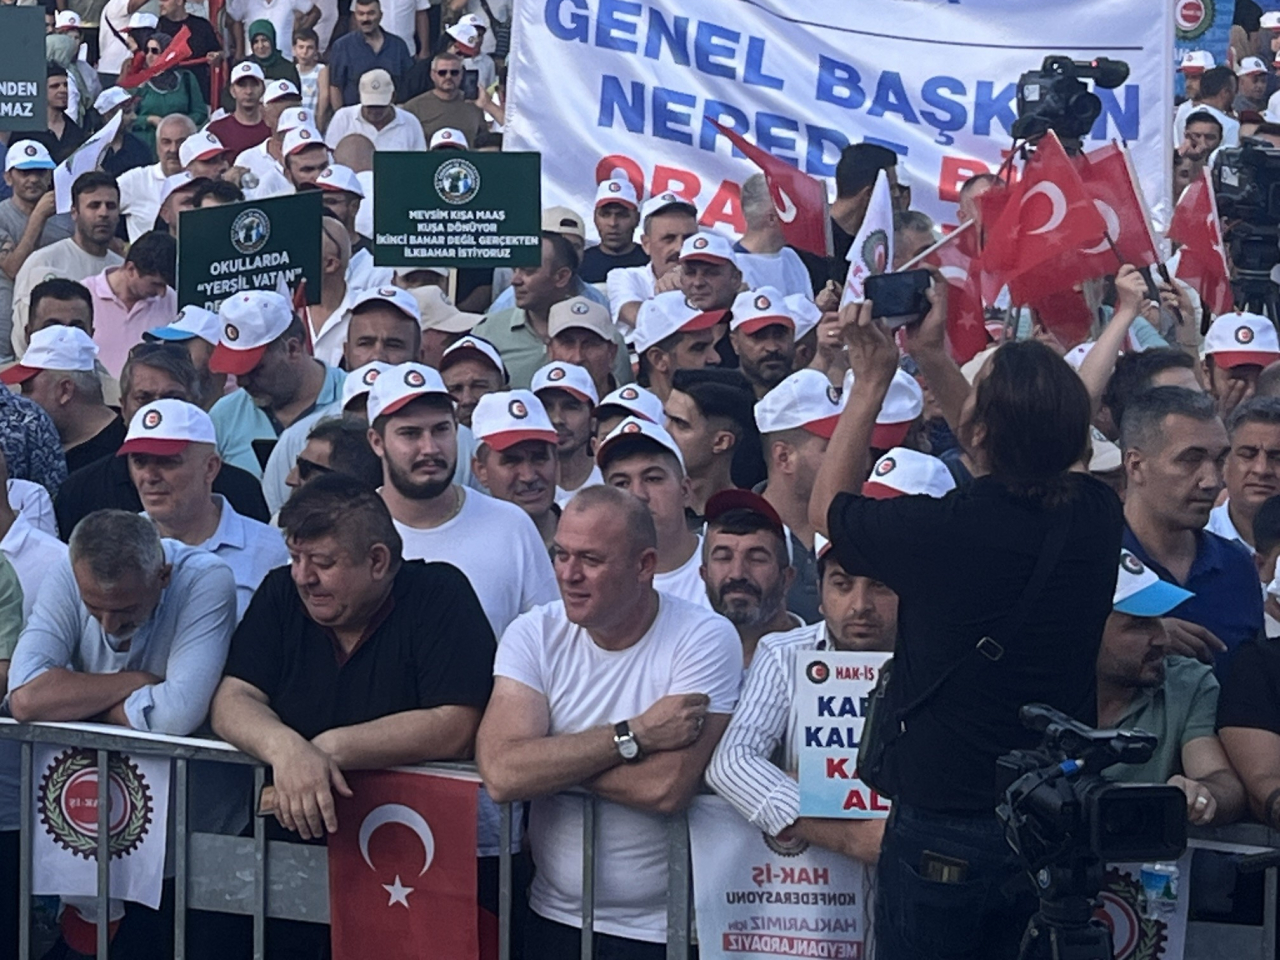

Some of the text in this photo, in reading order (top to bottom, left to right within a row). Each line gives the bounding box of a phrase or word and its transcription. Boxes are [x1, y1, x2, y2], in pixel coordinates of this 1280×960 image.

[816, 53, 1139, 146] BAŞKN
[598, 74, 908, 178] NERED
[409, 209, 448, 220] MEVSİM
[476, 210, 505, 221] MAAŞ
[596, 154, 748, 234] ORA
[447, 222, 497, 232] DÖNÜYOR
[210, 251, 289, 275] OKULLARDA
